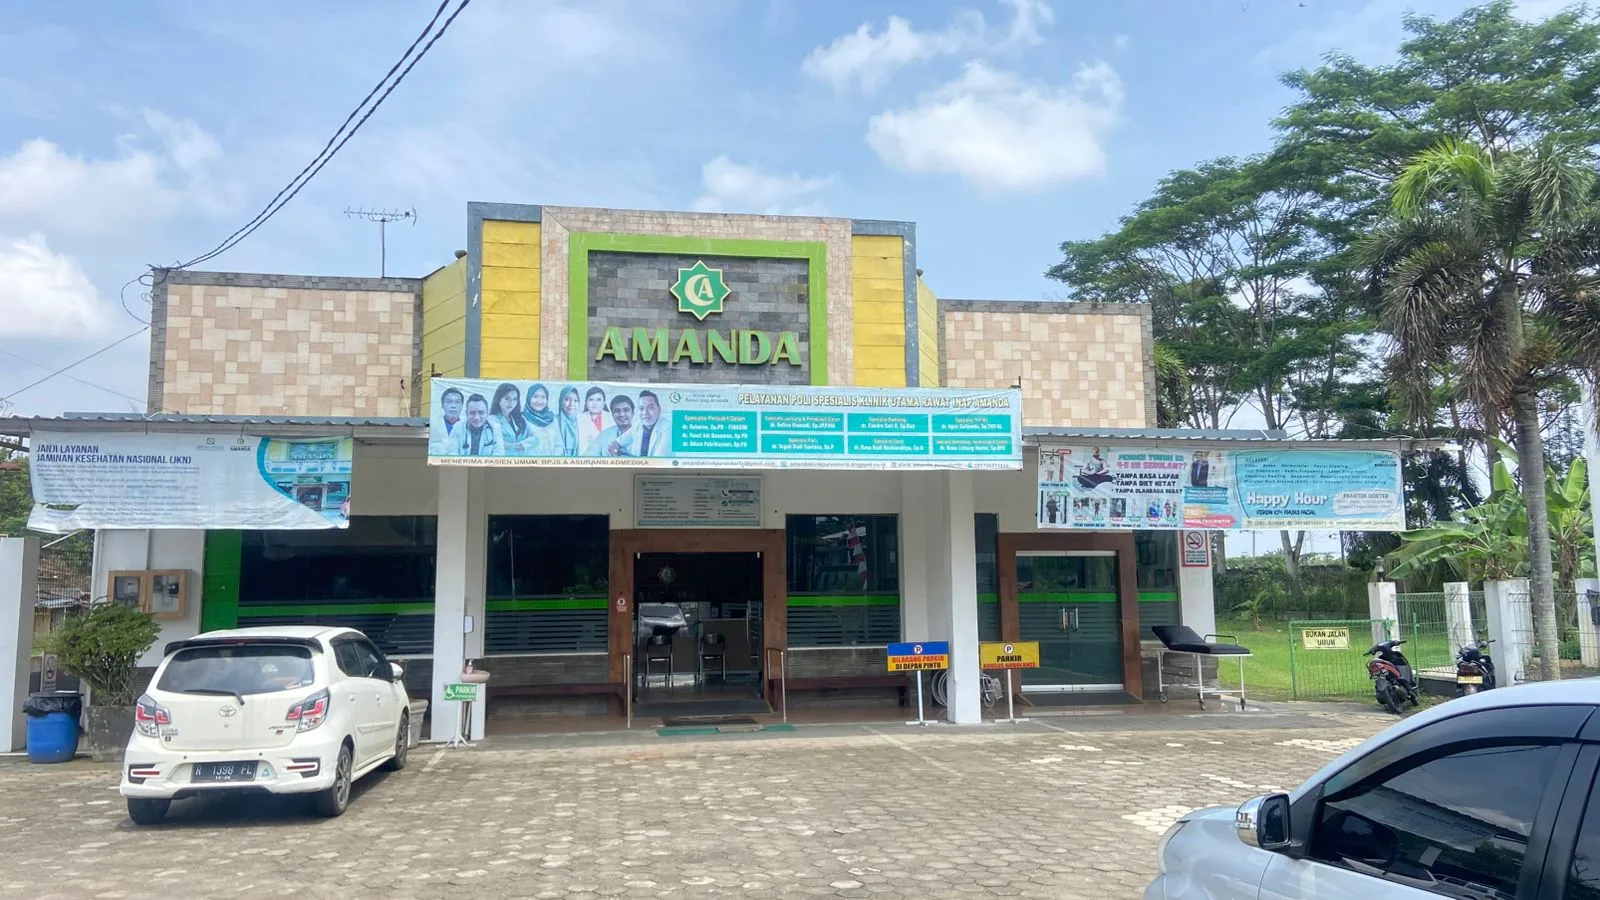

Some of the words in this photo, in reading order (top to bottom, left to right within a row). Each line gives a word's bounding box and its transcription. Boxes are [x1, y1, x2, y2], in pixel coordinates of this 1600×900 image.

[595, 326, 801, 366] AMANDA
[738, 393, 789, 406] PELAYANAN
[791, 394, 811, 406] POLI
[813, 395, 857, 407] SPESIALIS
[859, 396, 888, 408] KLINIK
[890, 396, 920, 408] UTAMA
[921, 396, 950, 409] RAWAT
[951, 397, 973, 409] INAP
[973, 397, 1010, 409] AMANDA
[36, 444, 58, 453] JANJI
[60, 444, 99, 454] LAYANAN
[36, 454, 74, 462] JAMINAN
[75, 454, 125, 463] KESEHATAN
[126, 455, 168, 464] NASIONAL
[169, 455, 192, 464] (JKN)
[1247, 491, 1291, 508] Happy
[1294, 491, 1328, 505] Hour
[1305, 630, 1326, 638] BUKAN
[1327, 630, 1346, 638] JALAN
[892, 655, 922, 663] DILARANG
[455, 685, 476, 694] PARKIR
[212, 765, 234, 776] 1398
[240, 765, 252, 775] FL
